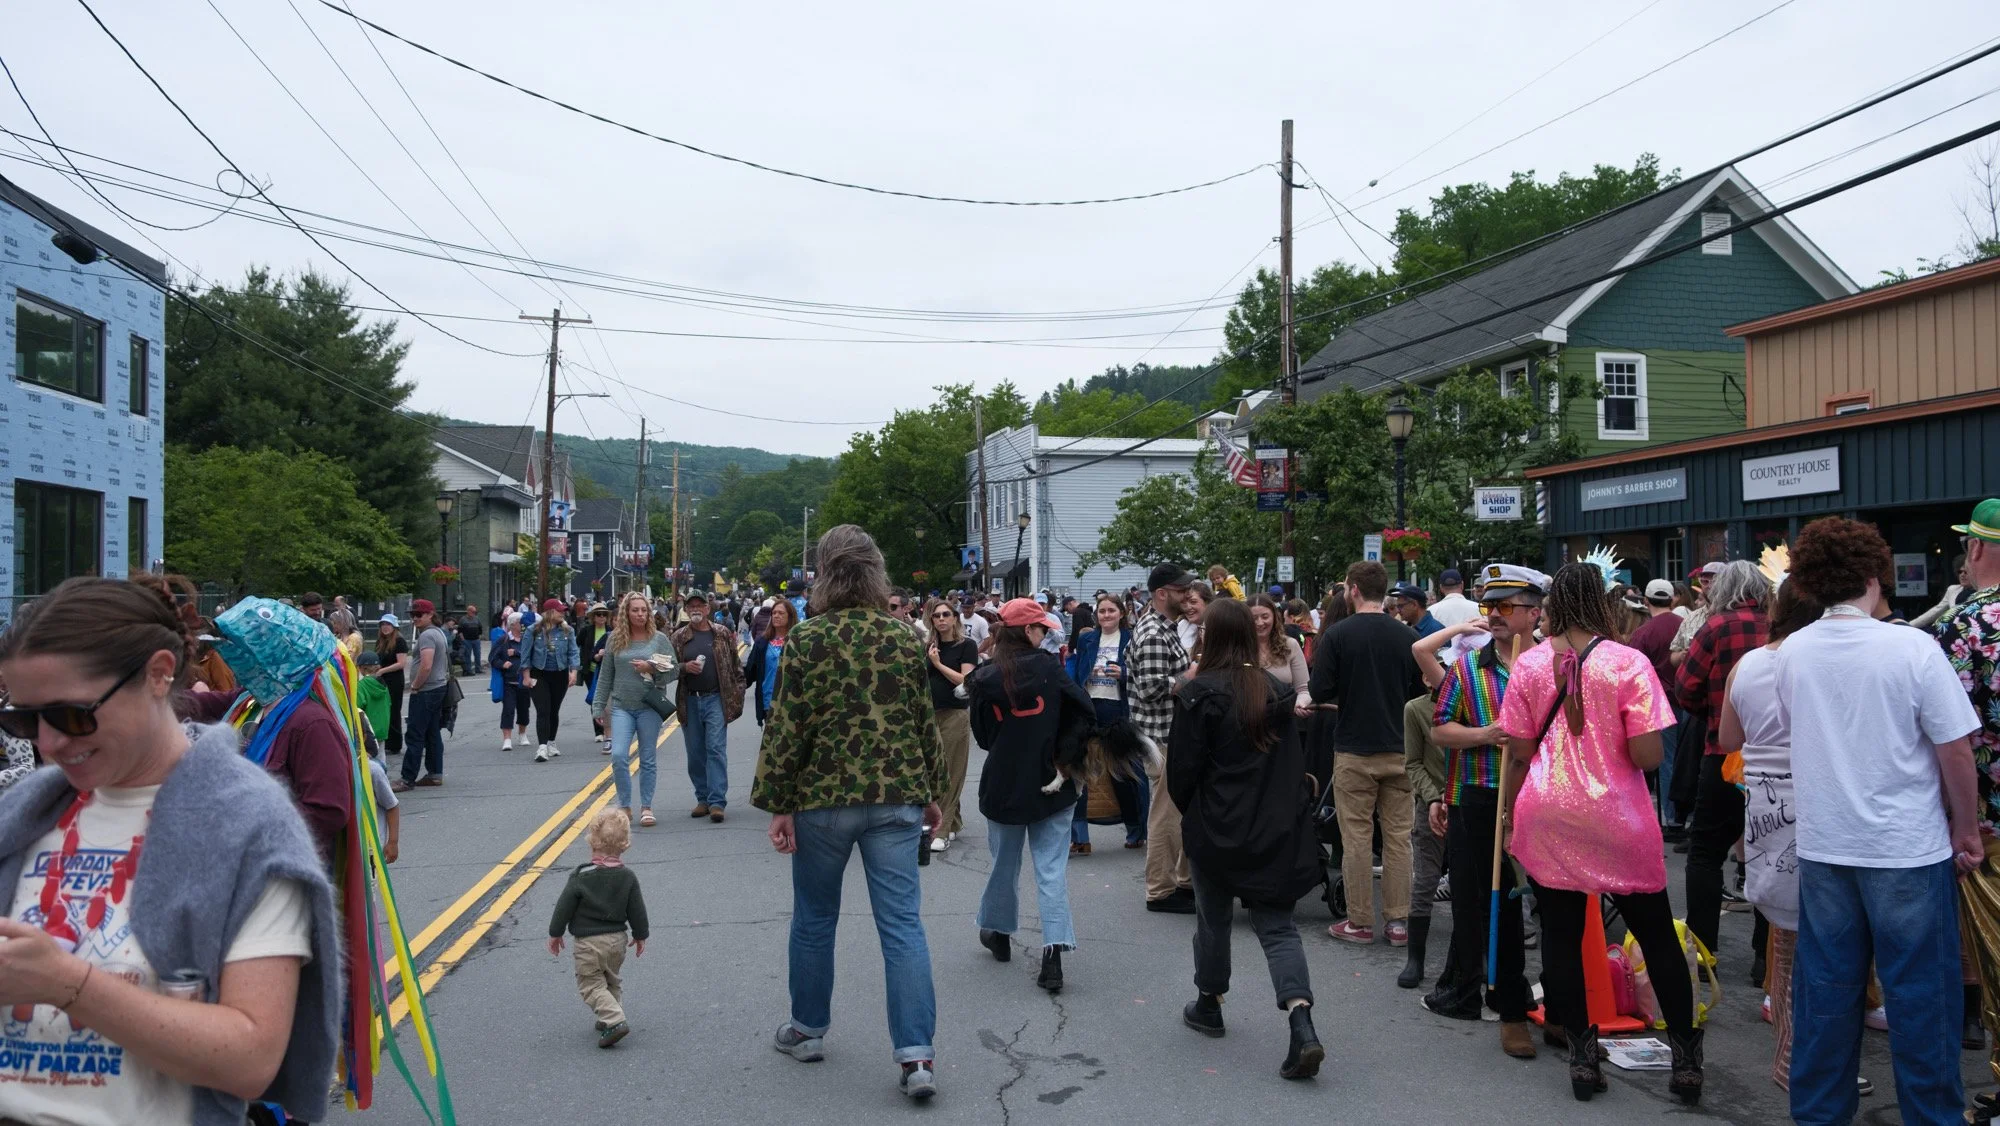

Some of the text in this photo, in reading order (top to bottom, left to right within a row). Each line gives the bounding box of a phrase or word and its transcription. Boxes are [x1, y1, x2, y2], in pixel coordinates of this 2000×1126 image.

[4, 236, 18, 247] SIGA
[28, 393, 42, 403] SIGA
[0, 403, 8, 412] GA
[62, 402, 75, 412] SIGA
[94, 410, 105, 420] SIGA
[31, 463, 44, 473] SIGA
[1750, 459, 1831, 480] COUNTRY HOUSE
[64, 469, 76, 479] SIGA
[1777, 477, 1802, 487] REALTY
[1587, 478, 1678, 501] JOHNNY'S BARBER SHOP
[1482, 497, 1516, 505] BARBER
[1489, 505, 1511, 514] SHOP
[61, 873, 113, 891] FEVE
[0, 1050, 122, 1076] OUT PARADE
